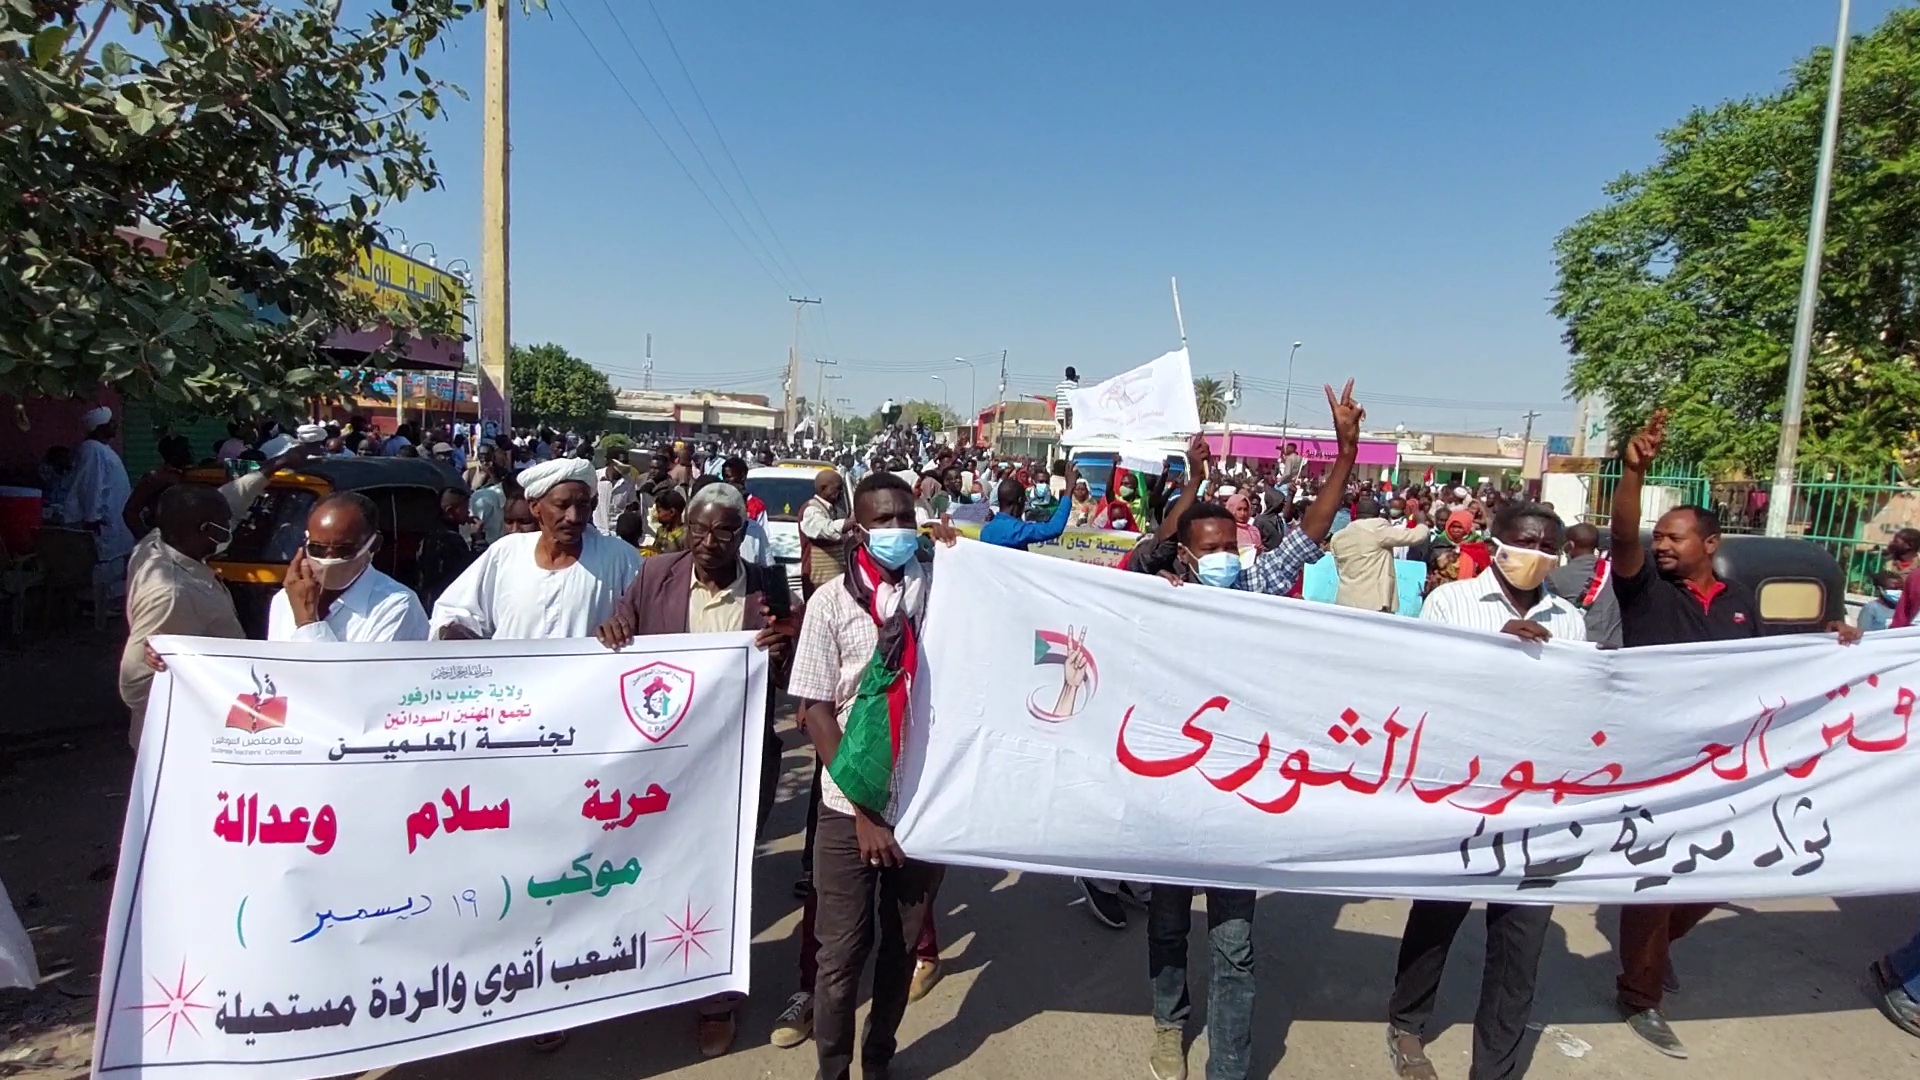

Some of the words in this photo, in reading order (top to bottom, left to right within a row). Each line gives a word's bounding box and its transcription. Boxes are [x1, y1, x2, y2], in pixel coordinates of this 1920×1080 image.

[397, 686, 441, 706] دارفور
[446, 685, 484, 705] جنوب
[488, 684, 523, 701] ولاية
[498, 703, 532, 724] تجمع
[328, 729, 466, 761] المعلمين
[475, 725, 576, 754] لجنة
[1784, 673, 1917, 779] فتر
[213, 791, 338, 855] وعدالة
[406, 784, 511, 854] سلام
[581, 778, 672, 831] حرية
[526, 852, 643, 906] موكب
[550, 931, 648, 992] الشعب
[215, 989, 358, 1046] مستحيلة
[368, 962, 468, 1023] والردة
